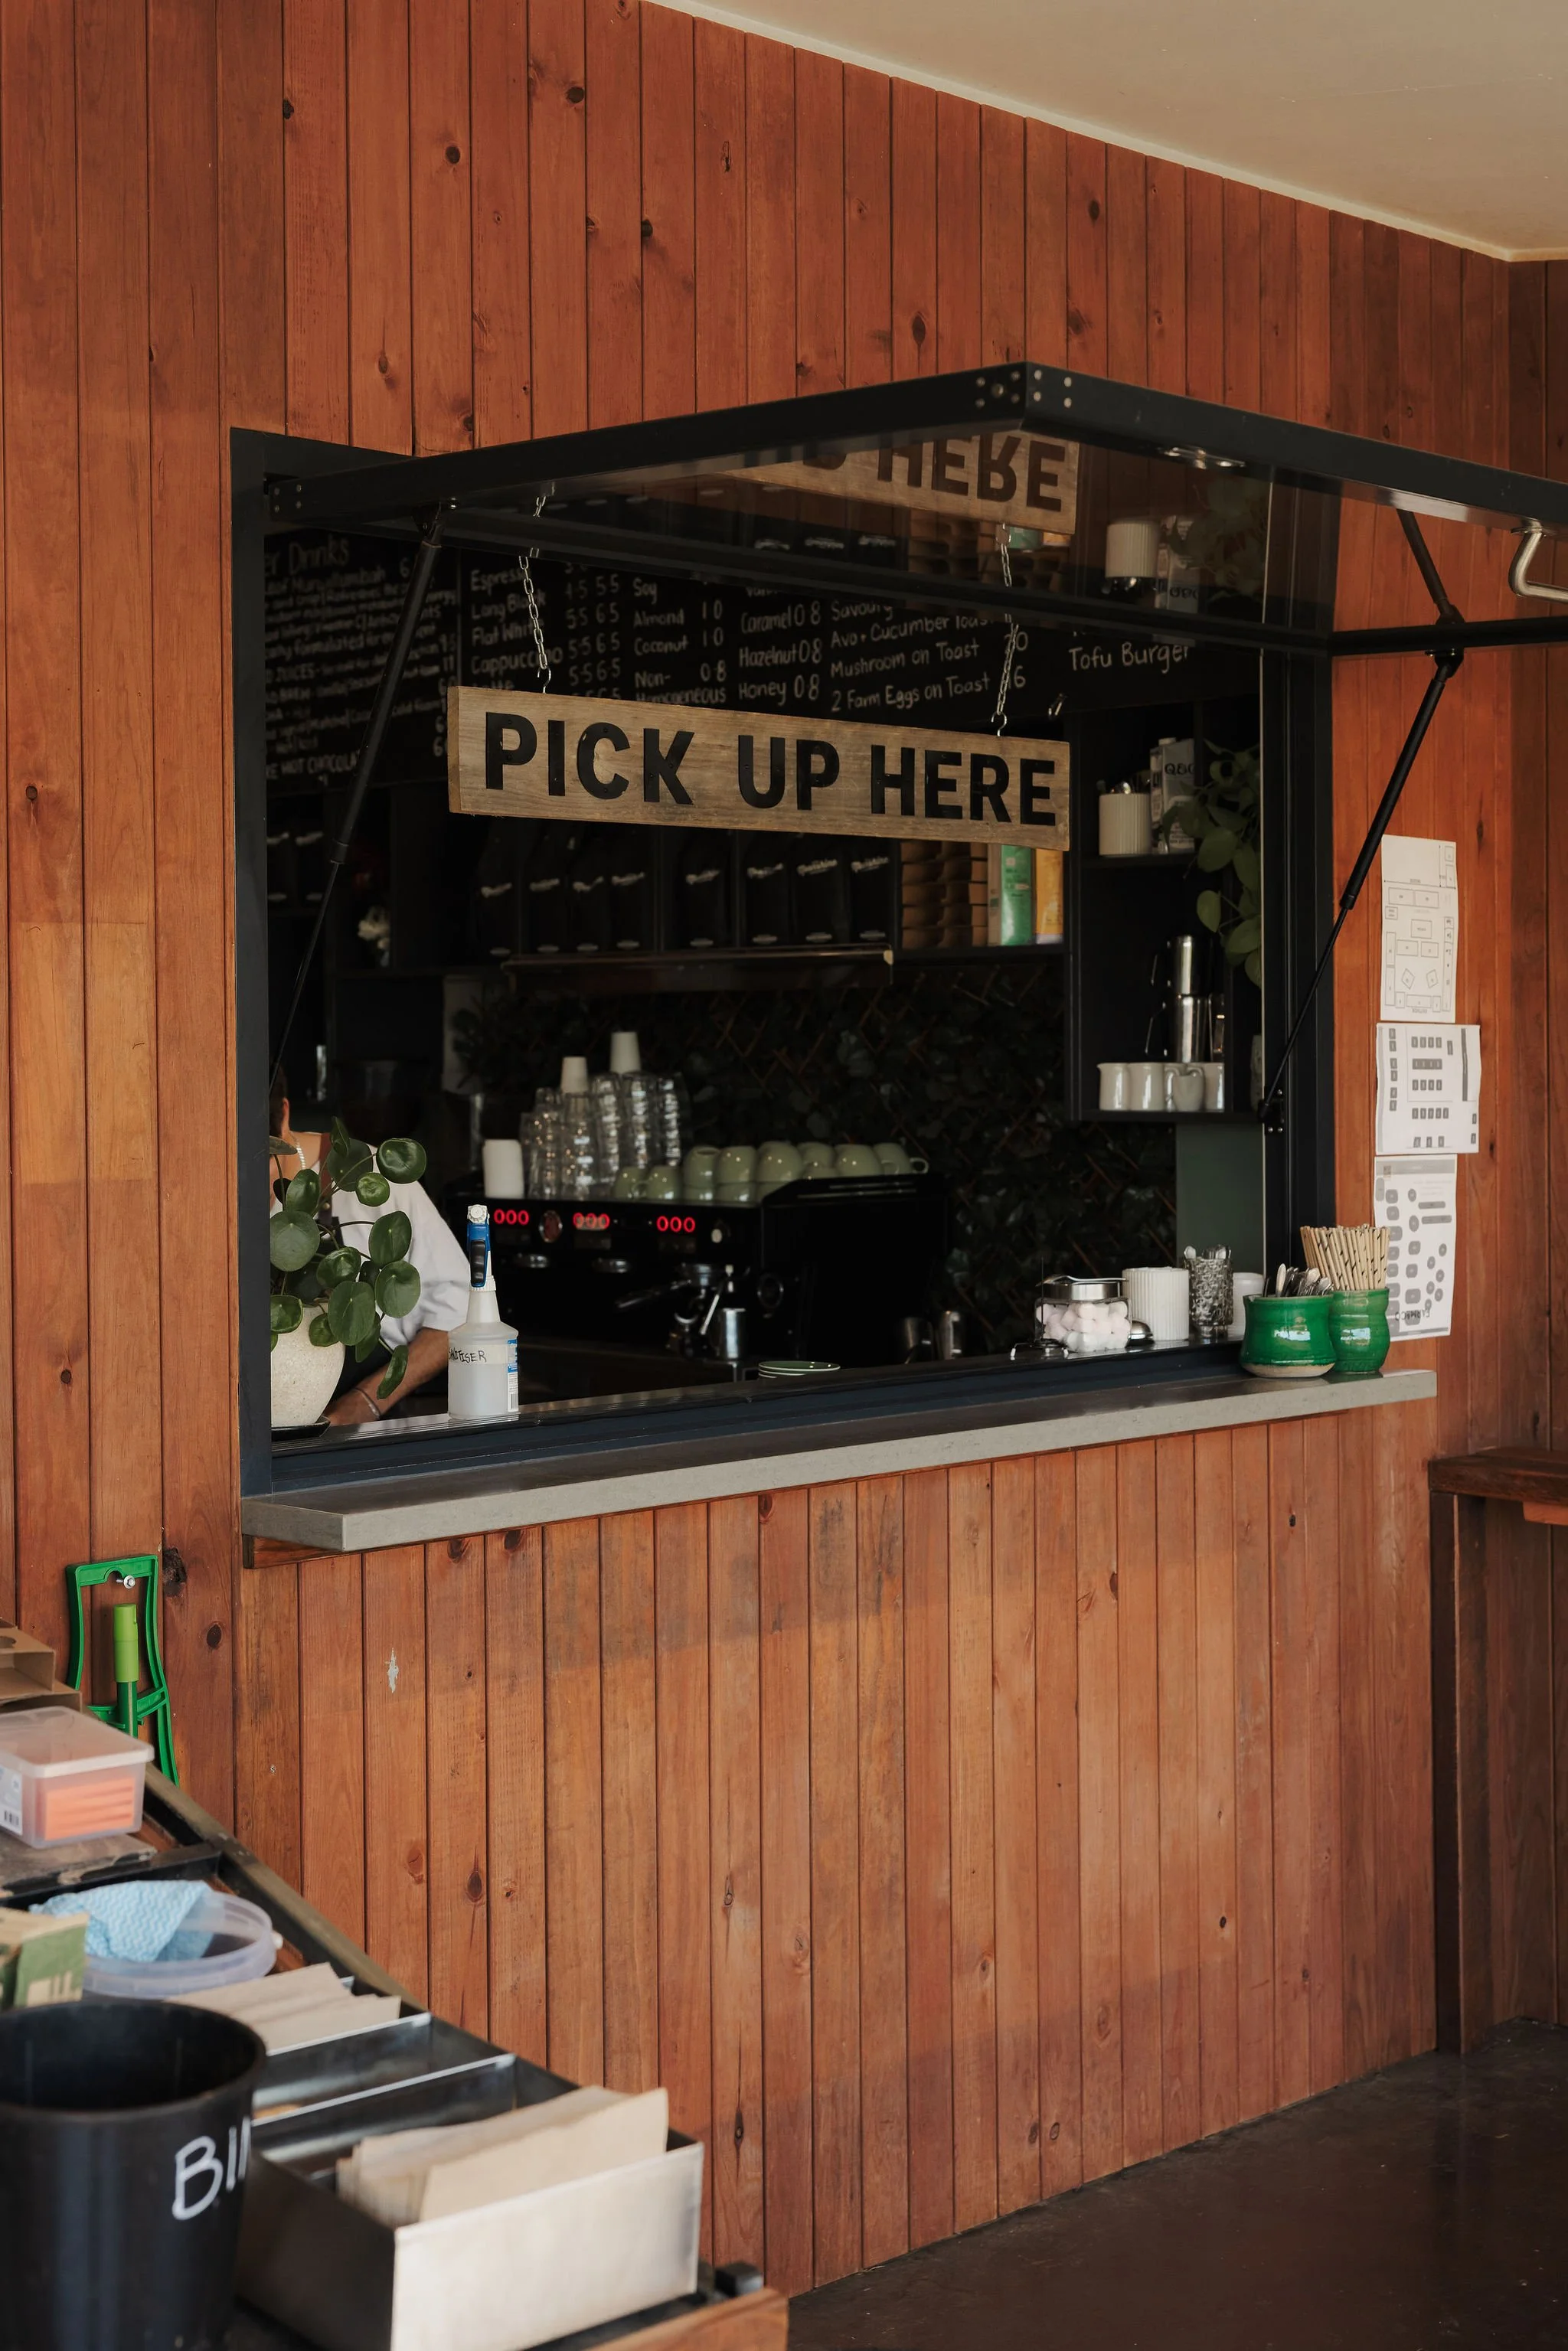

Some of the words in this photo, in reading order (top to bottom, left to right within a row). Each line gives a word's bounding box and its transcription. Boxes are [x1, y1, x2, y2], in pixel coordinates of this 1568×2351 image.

[632, 576, 658, 606] Soy
[633, 607, 686, 629] Almond
[741, 604, 792, 635] Caramel
[831, 630, 858, 648] Avo
[870, 616, 950, 642] Cucumber
[634, 634, 689, 656] Coconut
[739, 643, 798, 667] Hazelnut
[831, 651, 906, 678] Mushroom
[911, 648, 930, 665] on
[935, 637, 979, 663] Toast
[1068, 645, 1112, 671] Tofu
[1121, 642, 1189, 673] Burger
[738, 681, 786, 706] Honey
[831, 690, 842, 713] 2
[847, 689, 881, 710] Farm
[884, 684, 920, 710] Eggs
[924, 684, 943, 700] on
[944, 671, 991, 698] Toast
[485, 711, 695, 806] PICK
[737, 735, 840, 811] UP
[871, 744, 1057, 827] HERE
[494, 1209, 530, 1226] 000
[656, 1216, 696, 1233] 000
